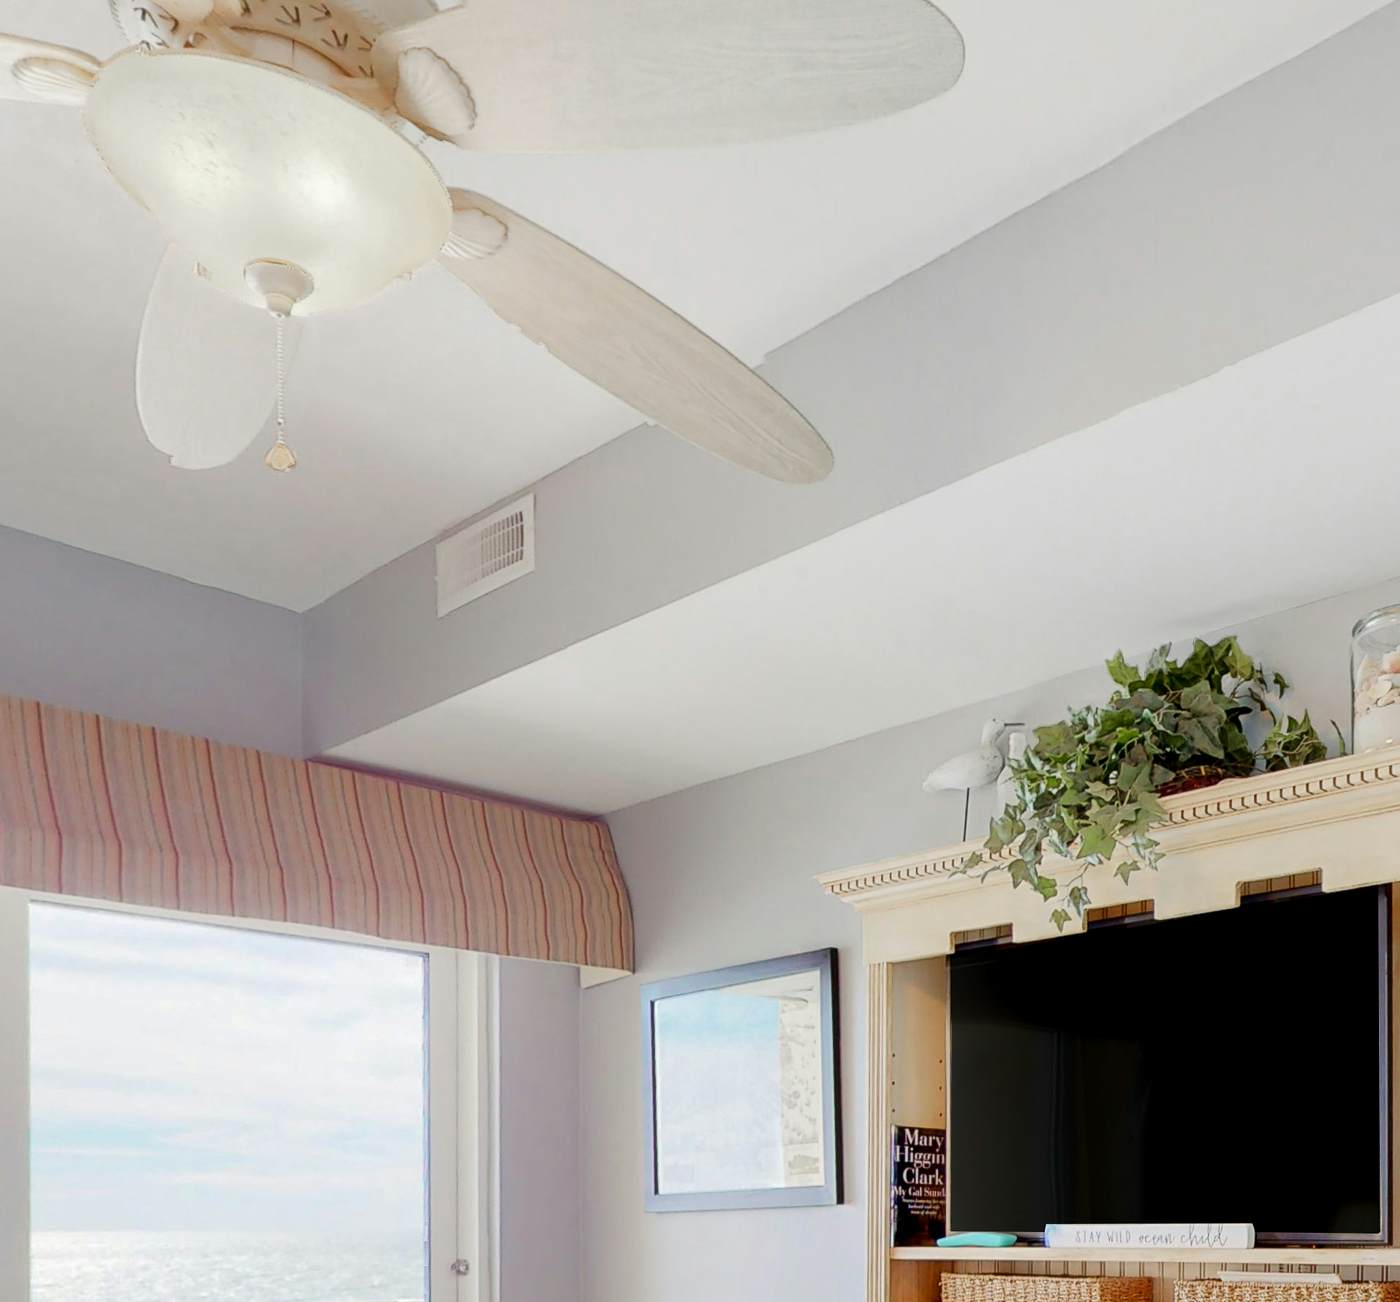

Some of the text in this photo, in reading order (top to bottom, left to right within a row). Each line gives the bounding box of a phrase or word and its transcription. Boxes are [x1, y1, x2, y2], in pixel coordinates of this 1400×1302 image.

[905, 1128, 944, 1152] Mary
[903, 1167, 944, 1185] Clark
[893, 1186, 946, 1199] My Gal Sund
[1075, 1223, 1228, 1248] STAY WILD ocean child
